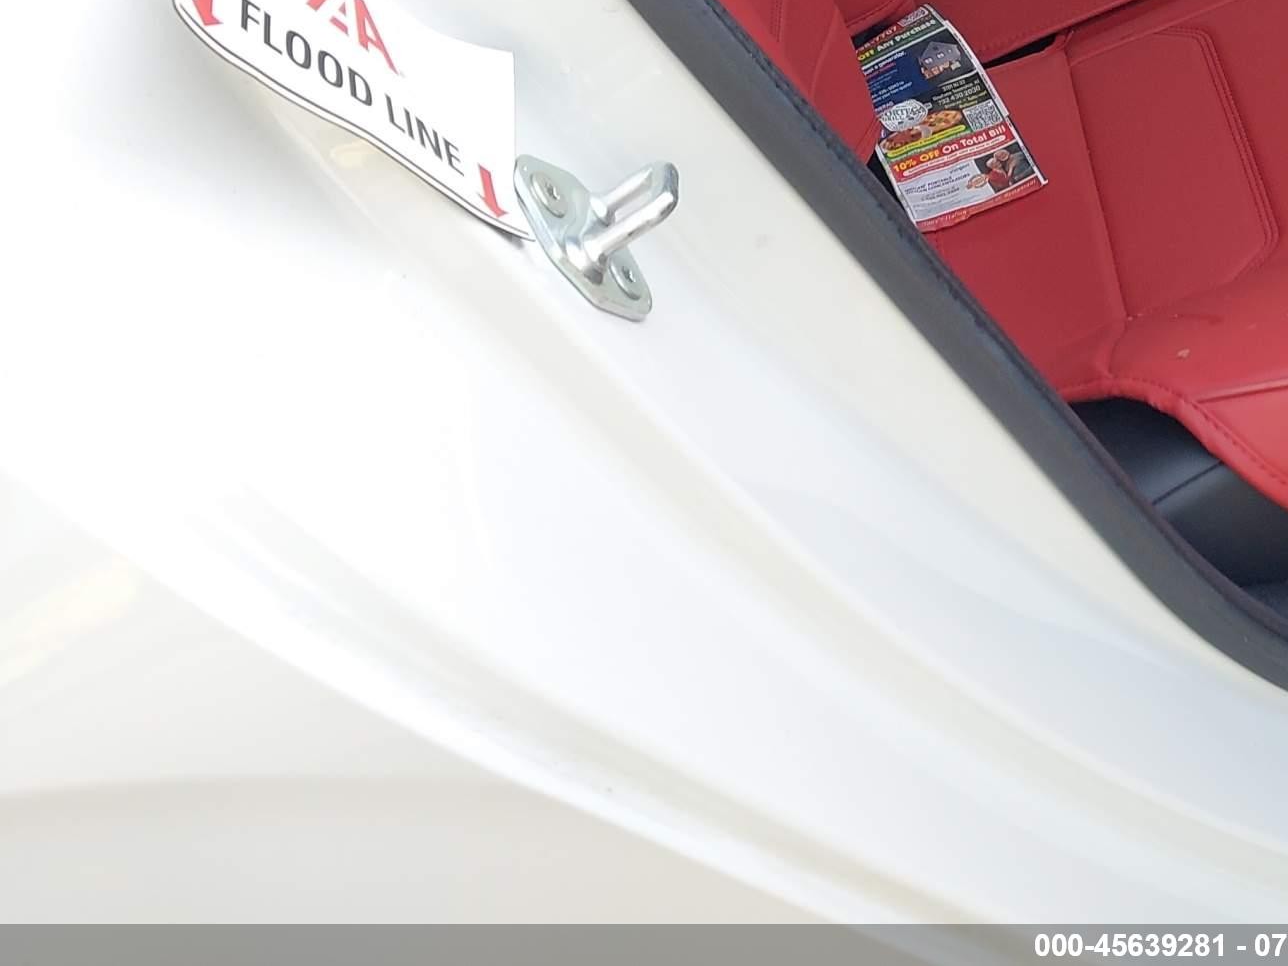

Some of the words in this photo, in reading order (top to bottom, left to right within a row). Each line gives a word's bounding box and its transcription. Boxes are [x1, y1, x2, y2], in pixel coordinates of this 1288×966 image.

[877, 39, 894, 52] Any
[895, 19, 936, 42] Purchase
[949, 92, 963, 101] 430
[963, 86, 981, 96] 2030
[385, 94, 465, 176] LINE
[893, 158, 917, 172] 10%
[942, 142, 959, 154] On
[960, 133, 987, 148] Total
[990, 125, 1006, 137] Bill
